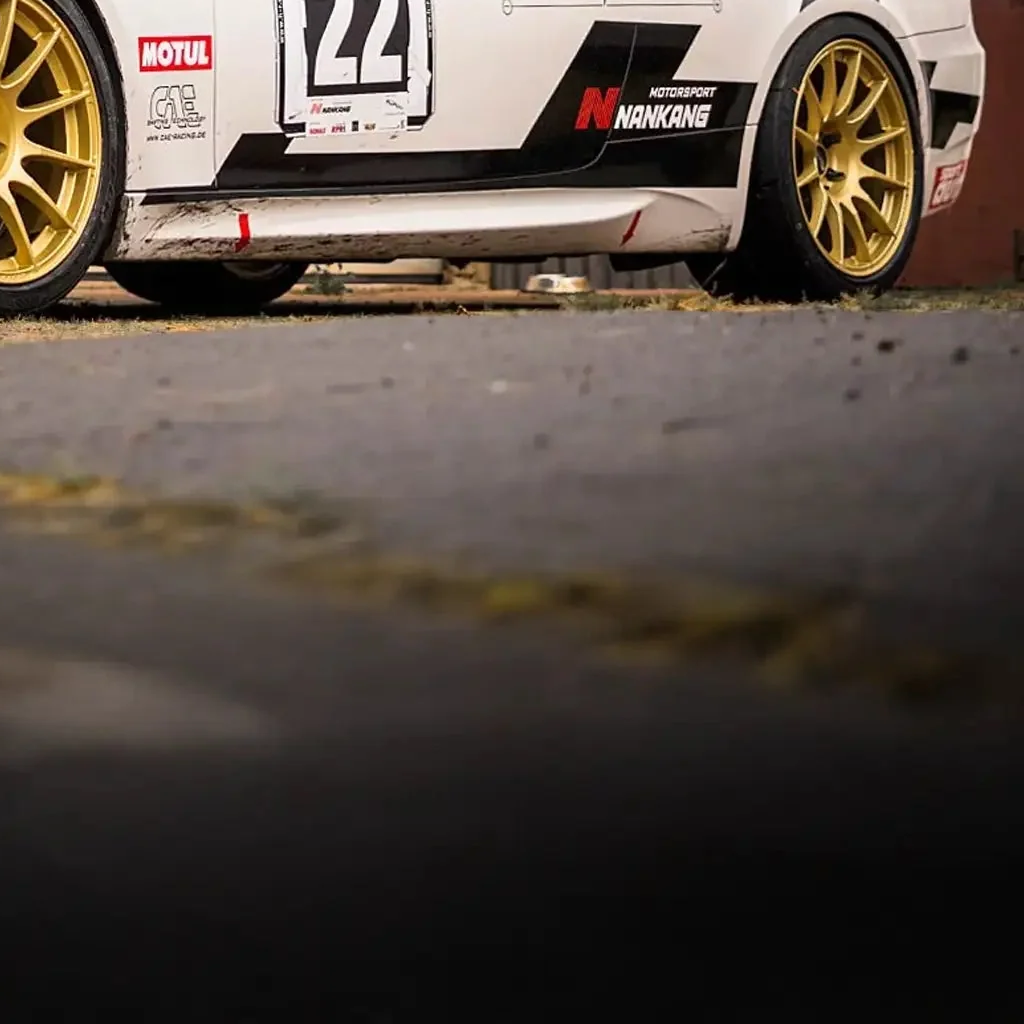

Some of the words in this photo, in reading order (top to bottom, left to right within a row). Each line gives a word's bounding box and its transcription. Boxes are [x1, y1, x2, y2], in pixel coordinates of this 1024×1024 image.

[141, 40, 210, 67] MOTUL
[649, 86, 717, 98] MOTORSPORT
[613, 104, 713, 129] NANKANG
